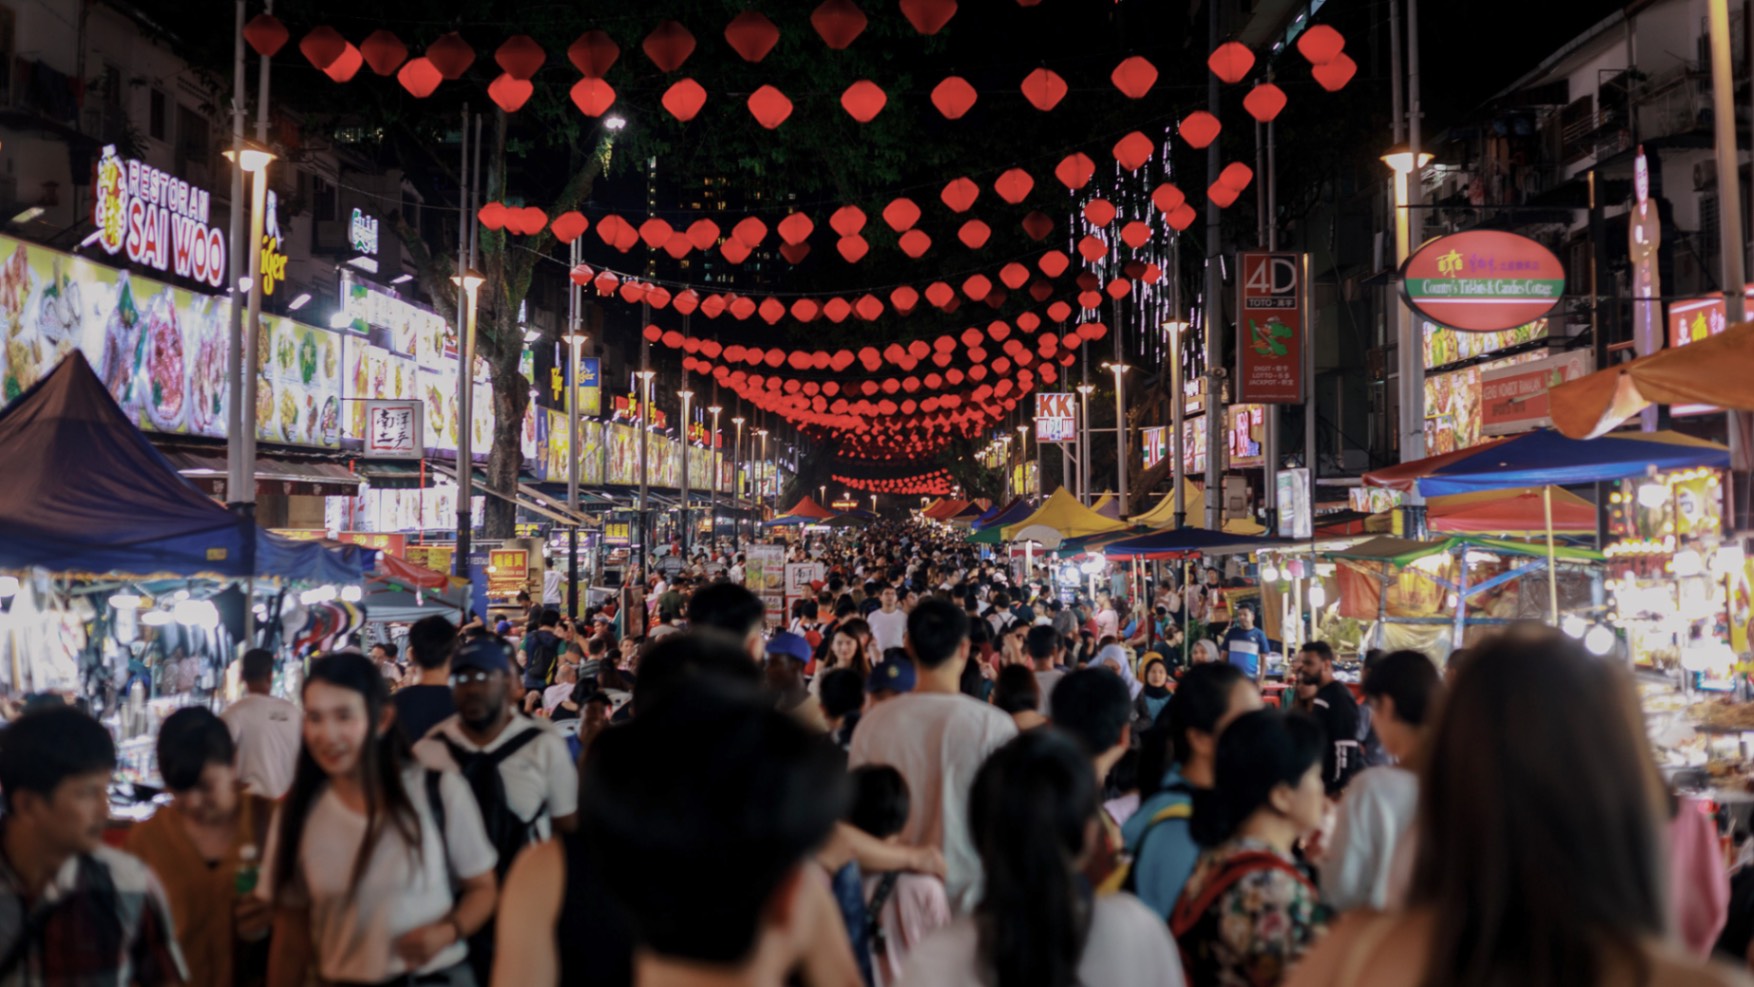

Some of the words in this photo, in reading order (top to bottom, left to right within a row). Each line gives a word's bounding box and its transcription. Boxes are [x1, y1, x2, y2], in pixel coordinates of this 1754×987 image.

[128, 159, 210, 224] RESTORAN
[126, 197, 169, 271] SAI
[171, 212, 226, 287] WOO
[260, 235, 288, 296] iger
[1246, 258, 1297, 293] 4D
[1249, 299, 1272, 307] TOTO
[1039, 394, 1072, 417] KK
